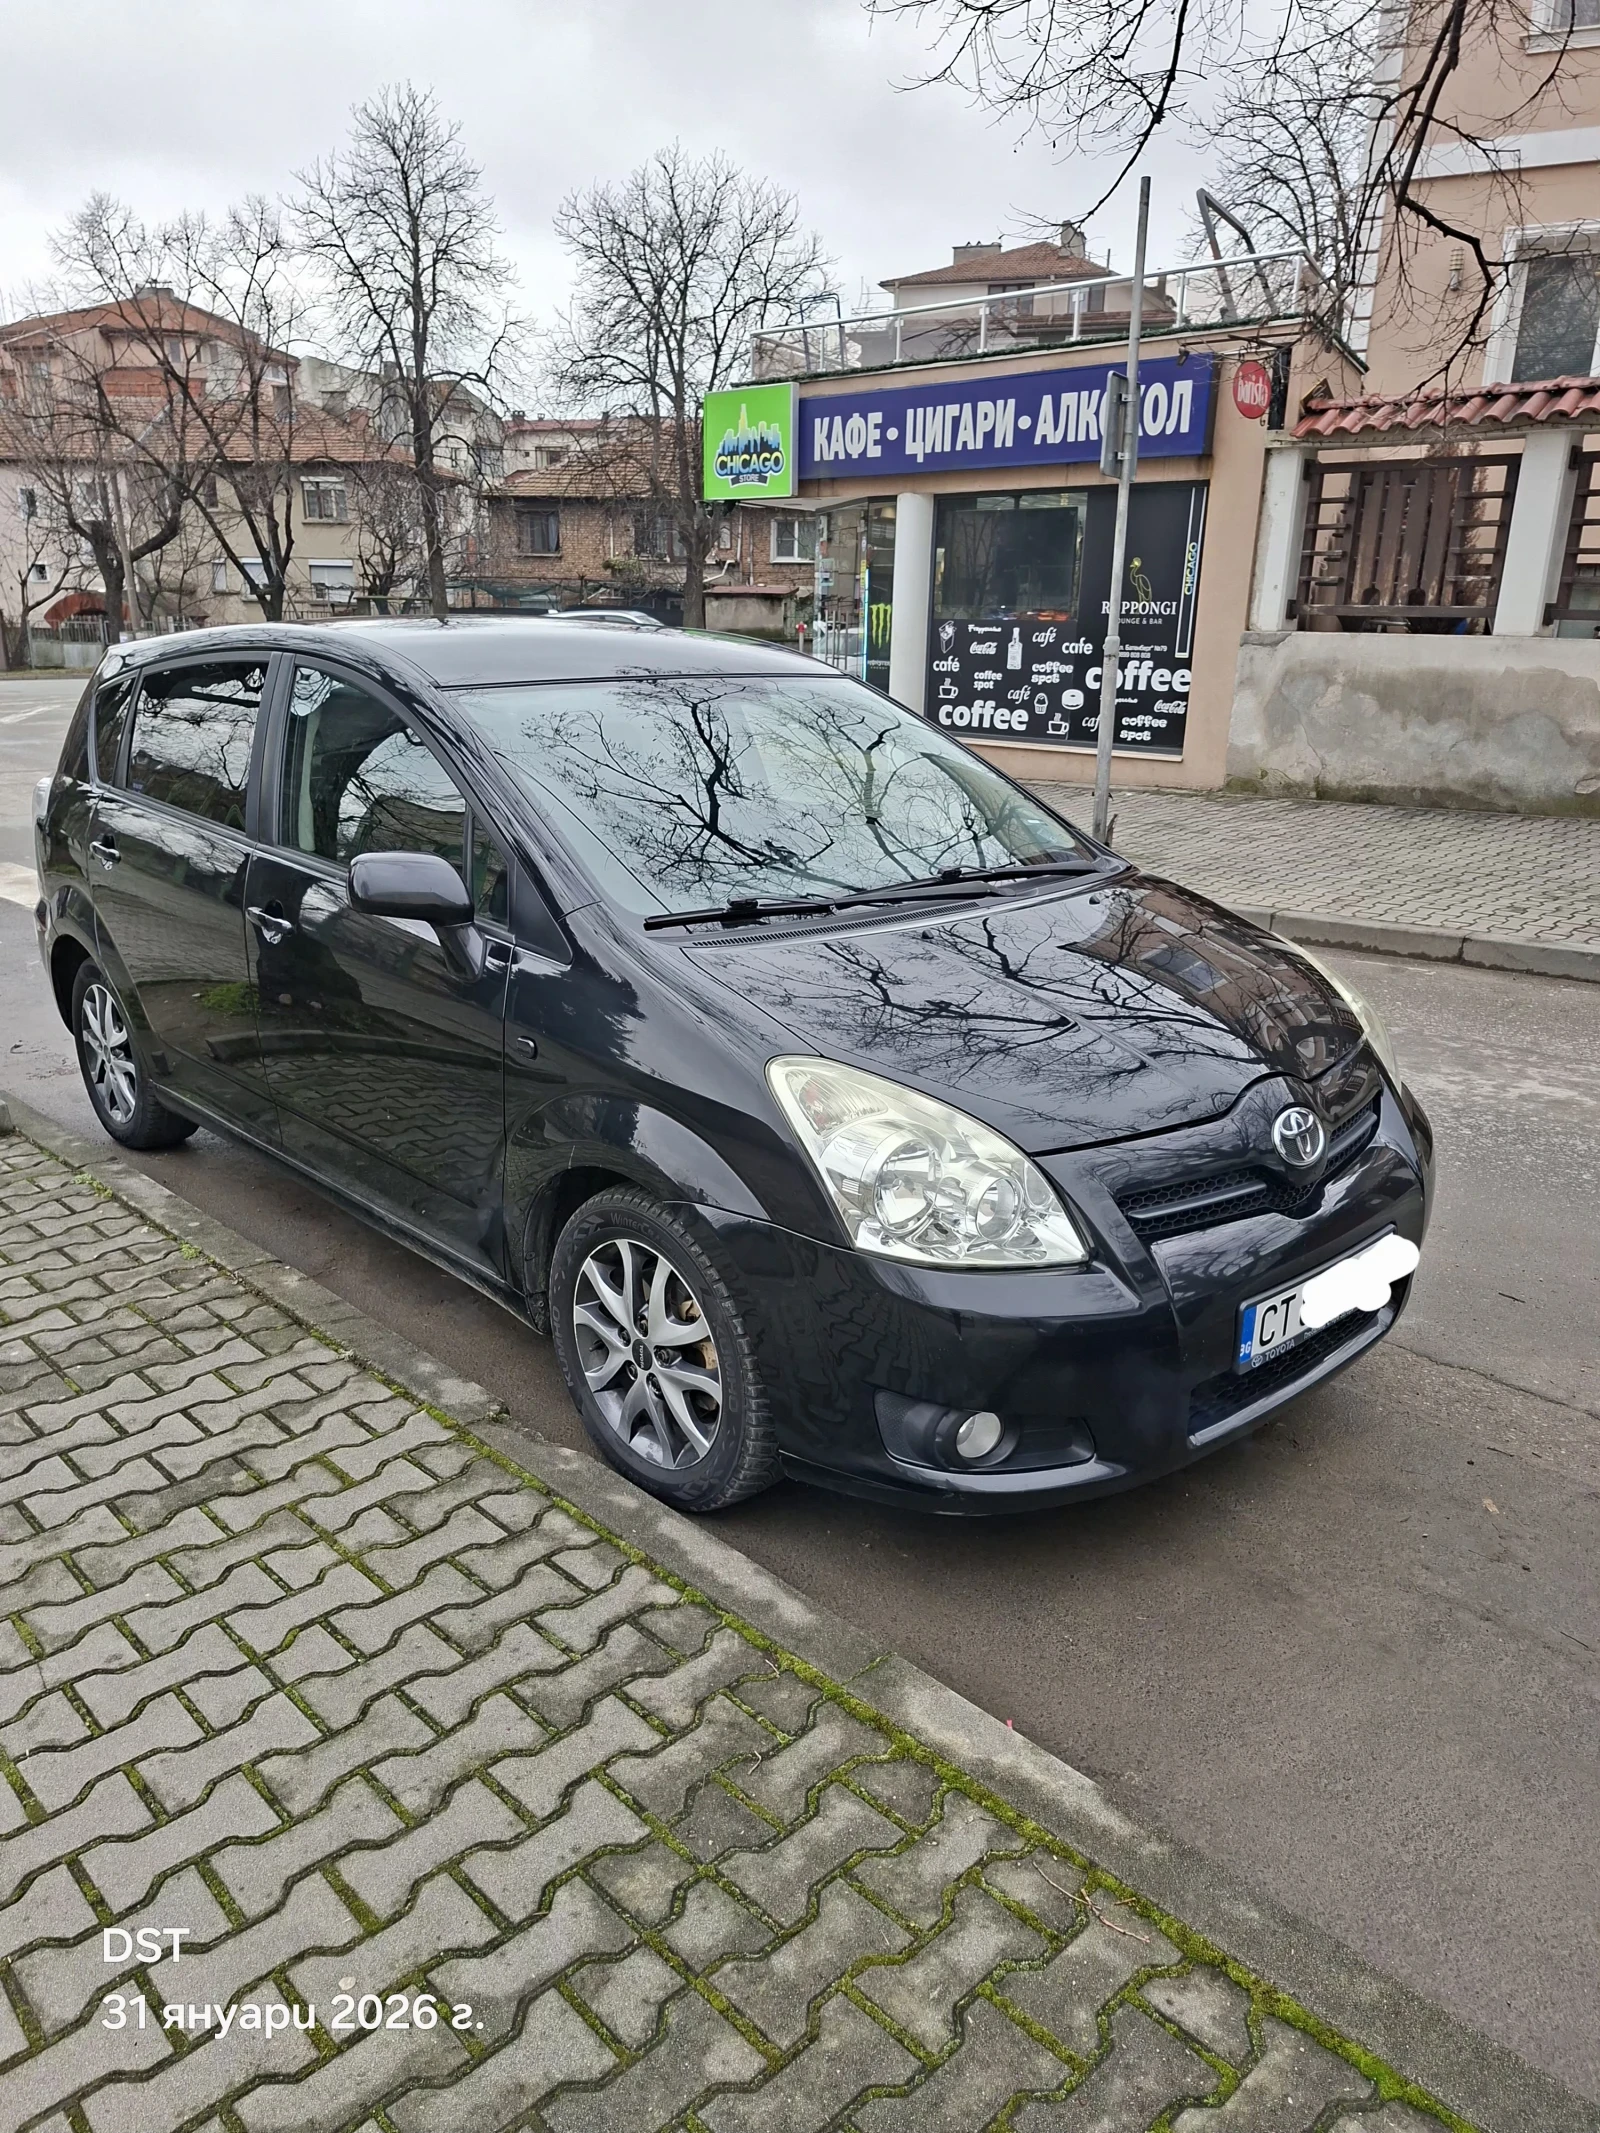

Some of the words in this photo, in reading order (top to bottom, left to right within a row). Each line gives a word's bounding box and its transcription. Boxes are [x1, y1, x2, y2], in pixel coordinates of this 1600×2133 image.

[813, 411, 883, 462] КАФЕ
[905, 398, 1016, 463] ЦИГАРИ
[1034, 379, 1194, 446] АЛКОЛ
[716, 452, 784, 475] CHICAGO
[738, 474, 760, 483] STORE
[1184, 542, 1198, 595] CHICAGO
[1101, 601, 1177, 615] RPPONGI
[1032, 626, 1058, 648] café
[1061, 637, 1094, 655] cafe
[932, 655, 961, 672] café
[1031, 661, 1074, 674] coffee
[973, 670, 1003, 681] coffee
[1031, 673, 1061, 685] spot
[973, 681, 995, 691] spot
[1007, 685, 1032, 704] café
[938, 699, 1030, 731] coffee
[1081, 713, 1101, 732] caf
[1121, 714, 1168, 728] coffee
[1119, 729, 1152, 741] spot
[1258, 1293, 1297, 1347] CT
[551, 1304, 575, 1388] KUMHO
[1265, 1338, 1295, 1361] TOYOTA
[712, 1320, 739, 1413] KUMHO
